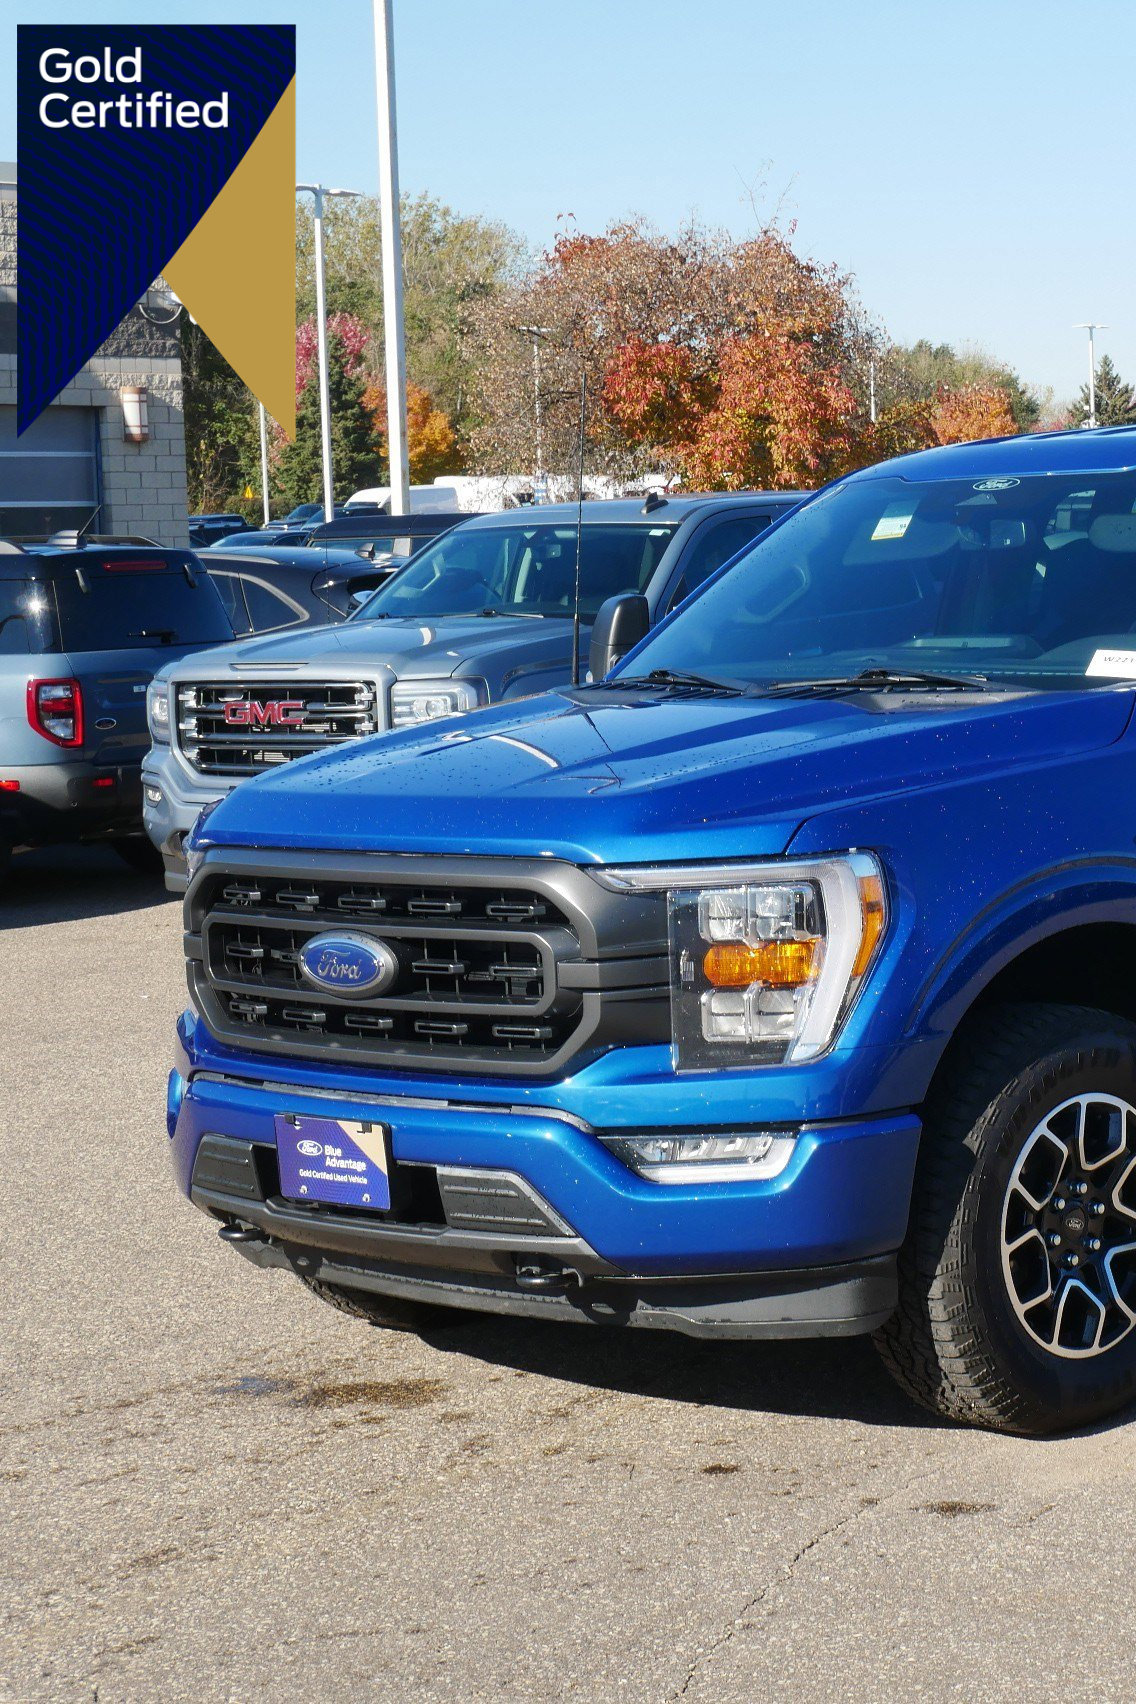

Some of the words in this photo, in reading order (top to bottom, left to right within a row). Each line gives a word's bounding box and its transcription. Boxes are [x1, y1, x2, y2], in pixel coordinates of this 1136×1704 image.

[224, 700, 305, 725] GMC
[317, 949, 362, 979] Ford
[302, 1142, 318, 1154] Ford
[324, 1144, 342, 1157] Blue
[325, 1156, 367, 1172] Advantage
[299, 1168, 312, 1178] Gold
[312, 1170, 333, 1181] Certified
[333, 1173, 347, 1182] Used
[348, 1175, 368, 1184] Vehicle
